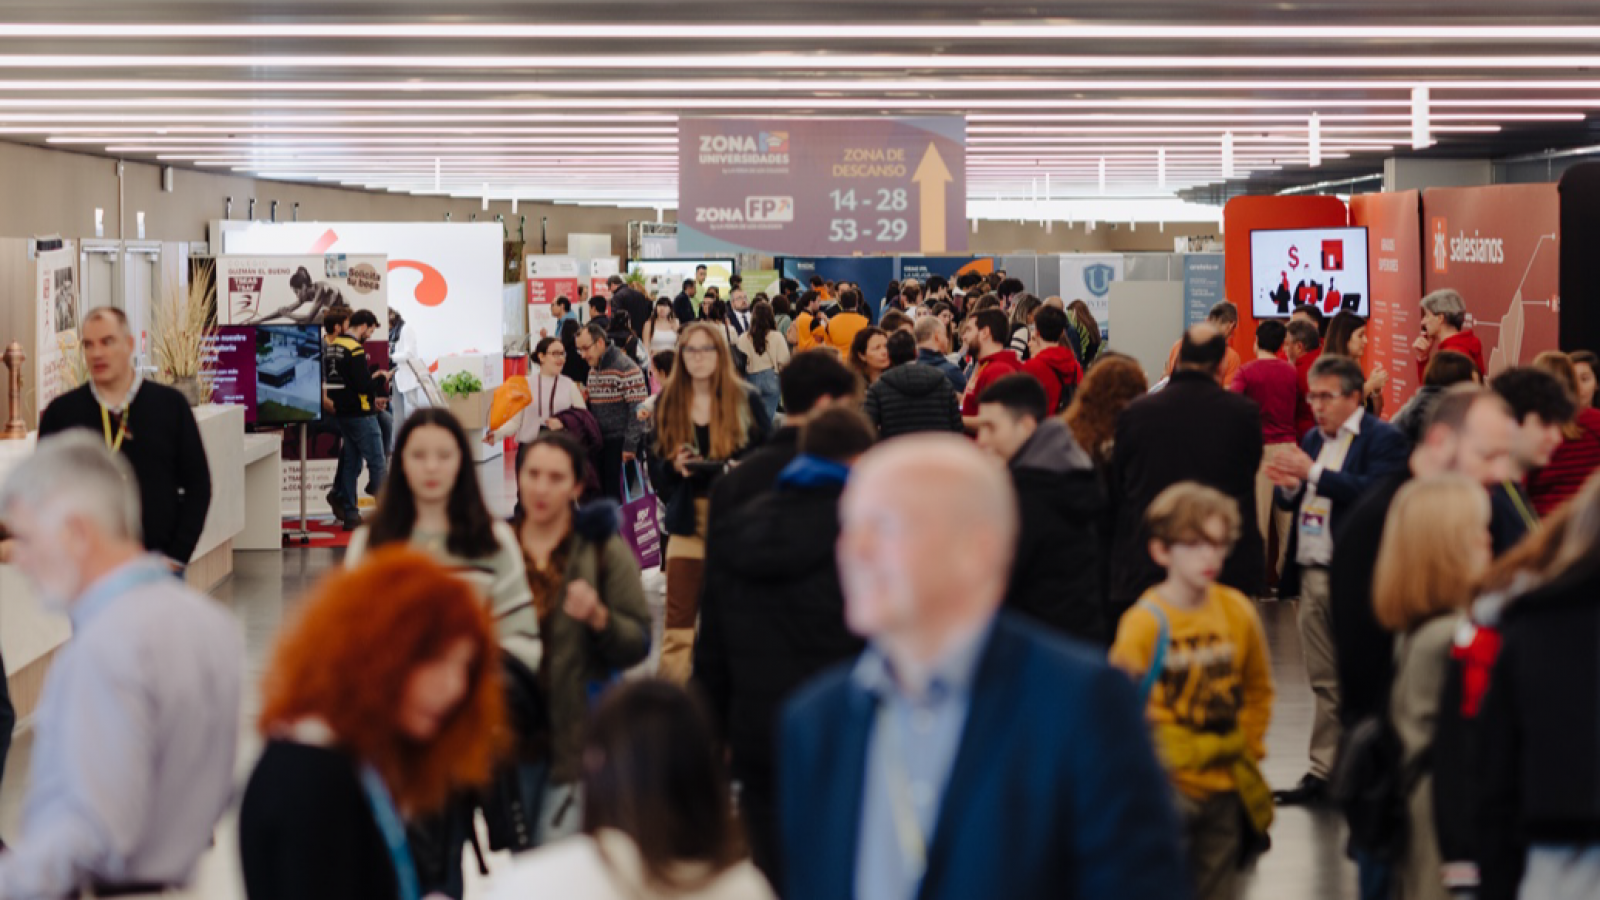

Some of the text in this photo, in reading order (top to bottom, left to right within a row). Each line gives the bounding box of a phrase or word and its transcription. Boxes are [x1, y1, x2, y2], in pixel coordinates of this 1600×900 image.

[699, 135, 757, 152] ZONA
[698, 153, 790, 165] UNIVERSIDADES
[843, 149, 905, 161] ZONA DE
[832, 165, 906, 177] DESCANSO
[829, 189, 857, 211] 14
[876, 188, 908, 211] 28
[695, 199, 776, 222] ZONA FP
[828, 219, 858, 242] 53
[876, 218, 908, 242] 29
[1450, 229, 1504, 264] salesianos
[347, 277, 357, 287] tu
[348, 266, 381, 282] Solicita
